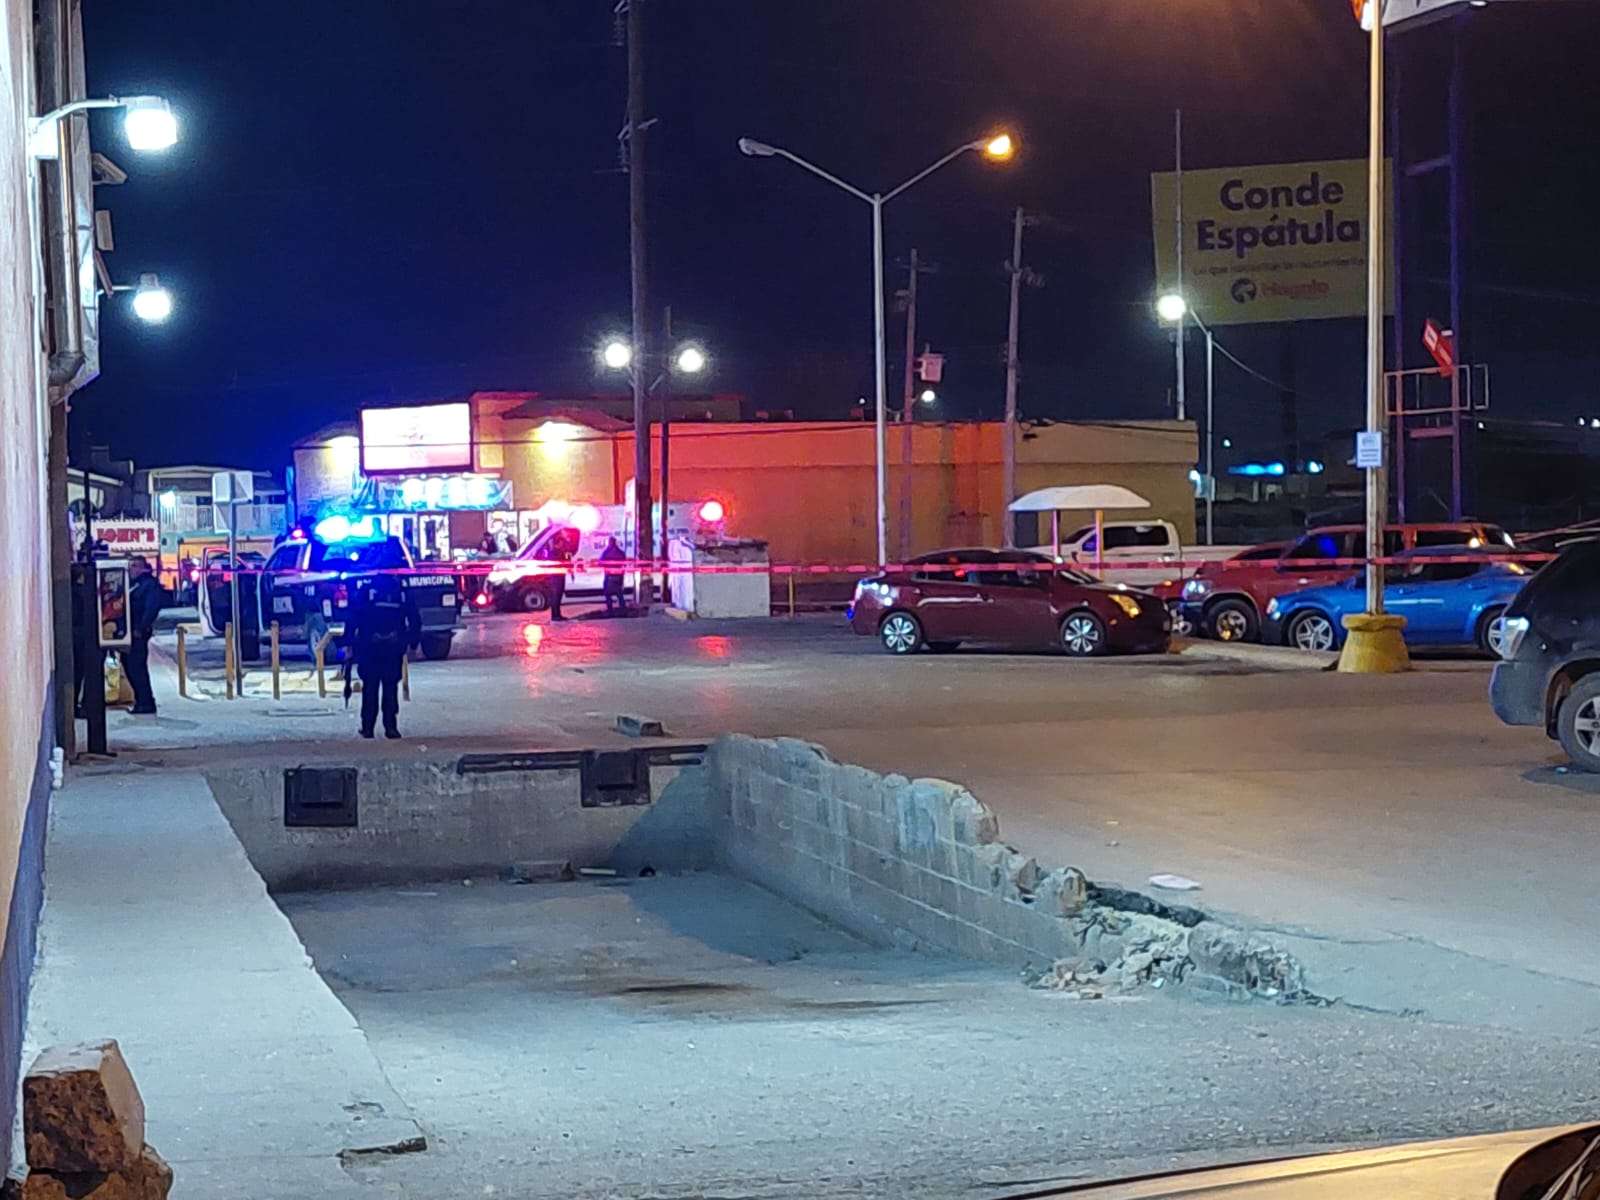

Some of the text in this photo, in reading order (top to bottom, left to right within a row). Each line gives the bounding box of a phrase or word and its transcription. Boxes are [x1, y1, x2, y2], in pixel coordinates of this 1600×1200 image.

[1220, 172, 1343, 211] Conde
[1197, 209, 1361, 259] Espátula
[408, 575, 455, 587] MUNICIPAL
